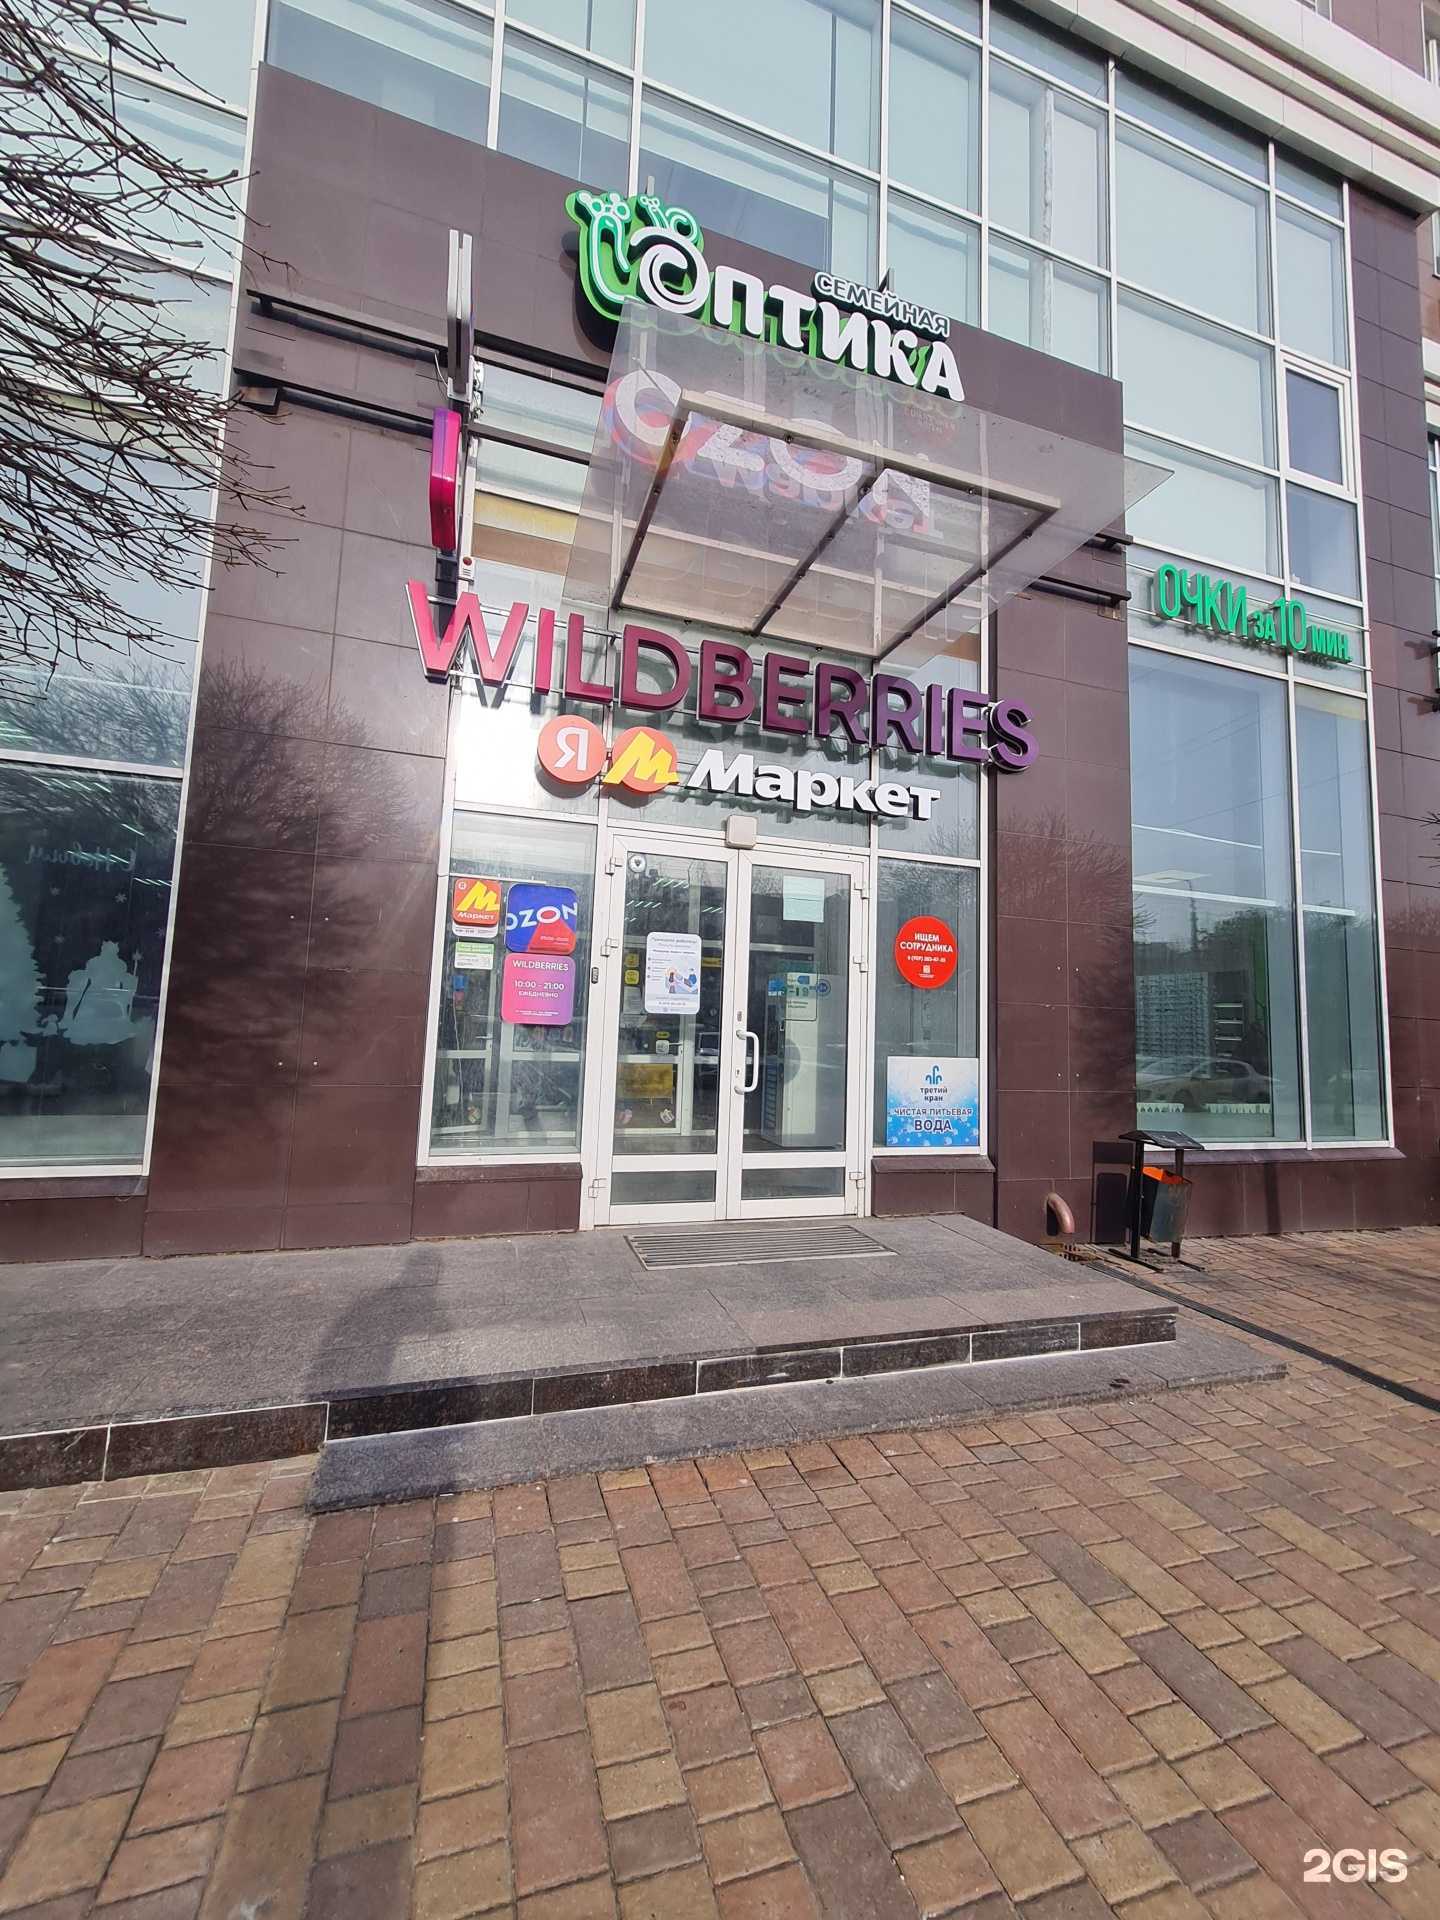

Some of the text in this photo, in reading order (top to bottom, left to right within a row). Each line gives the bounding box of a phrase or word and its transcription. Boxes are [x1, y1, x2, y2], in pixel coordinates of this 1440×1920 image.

[812, 271, 950, 339] СЕМЕЙНАЯ
[1157, 563, 1248, 638] ОЧКИ
[1273, 597, 1307, 651] 10
[405, 579, 1041, 773] WILDBERRIES
[689, 750, 941, 820] Маркет
[914, 933, 940, 942] ИЩЕМ
[900, 941, 953, 952] СОТРУДНИКА
[512, 959, 569, 971] WILDBERRIES
[515, 980, 537, 989] 10:00
[543, 982, 565, 991] 21:00
[920, 1086, 948, 1095] третий
[894, 1108, 972, 1116] ЧИСТАЯ ПИТЬЕВАЯ
[914, 1119, 952, 1133] ВОДА
